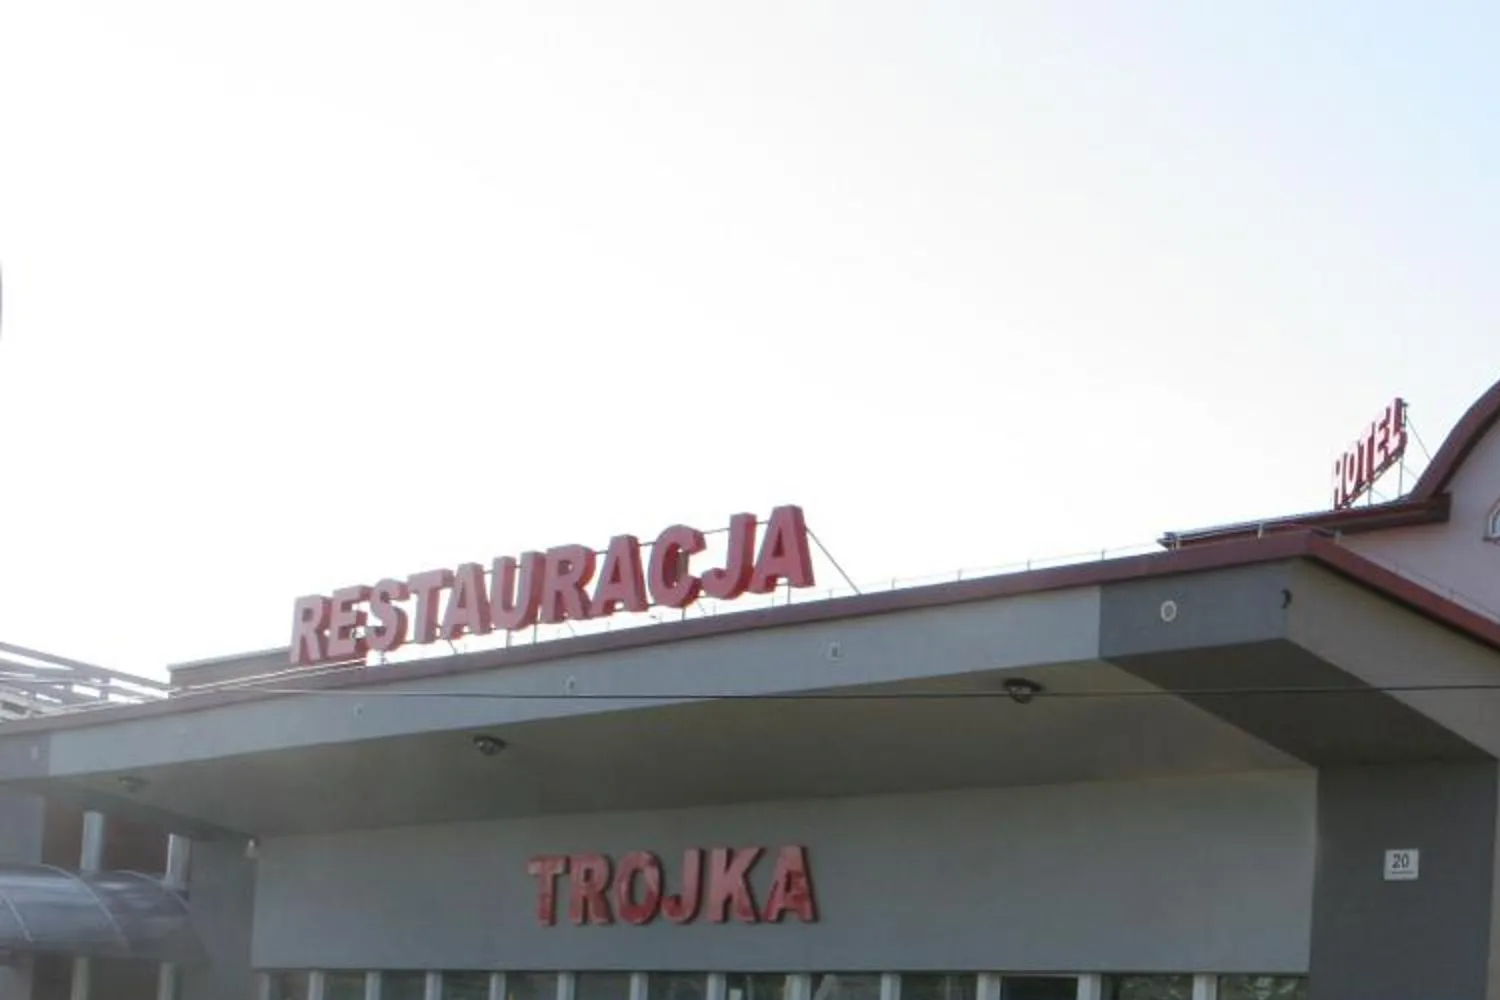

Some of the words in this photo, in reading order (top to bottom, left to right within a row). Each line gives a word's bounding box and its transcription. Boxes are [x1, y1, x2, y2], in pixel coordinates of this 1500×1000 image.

[289, 504, 815, 663] RESTAURACJA
[527, 846, 819, 926] TROJKA
[1391, 853, 1409, 869] 20
